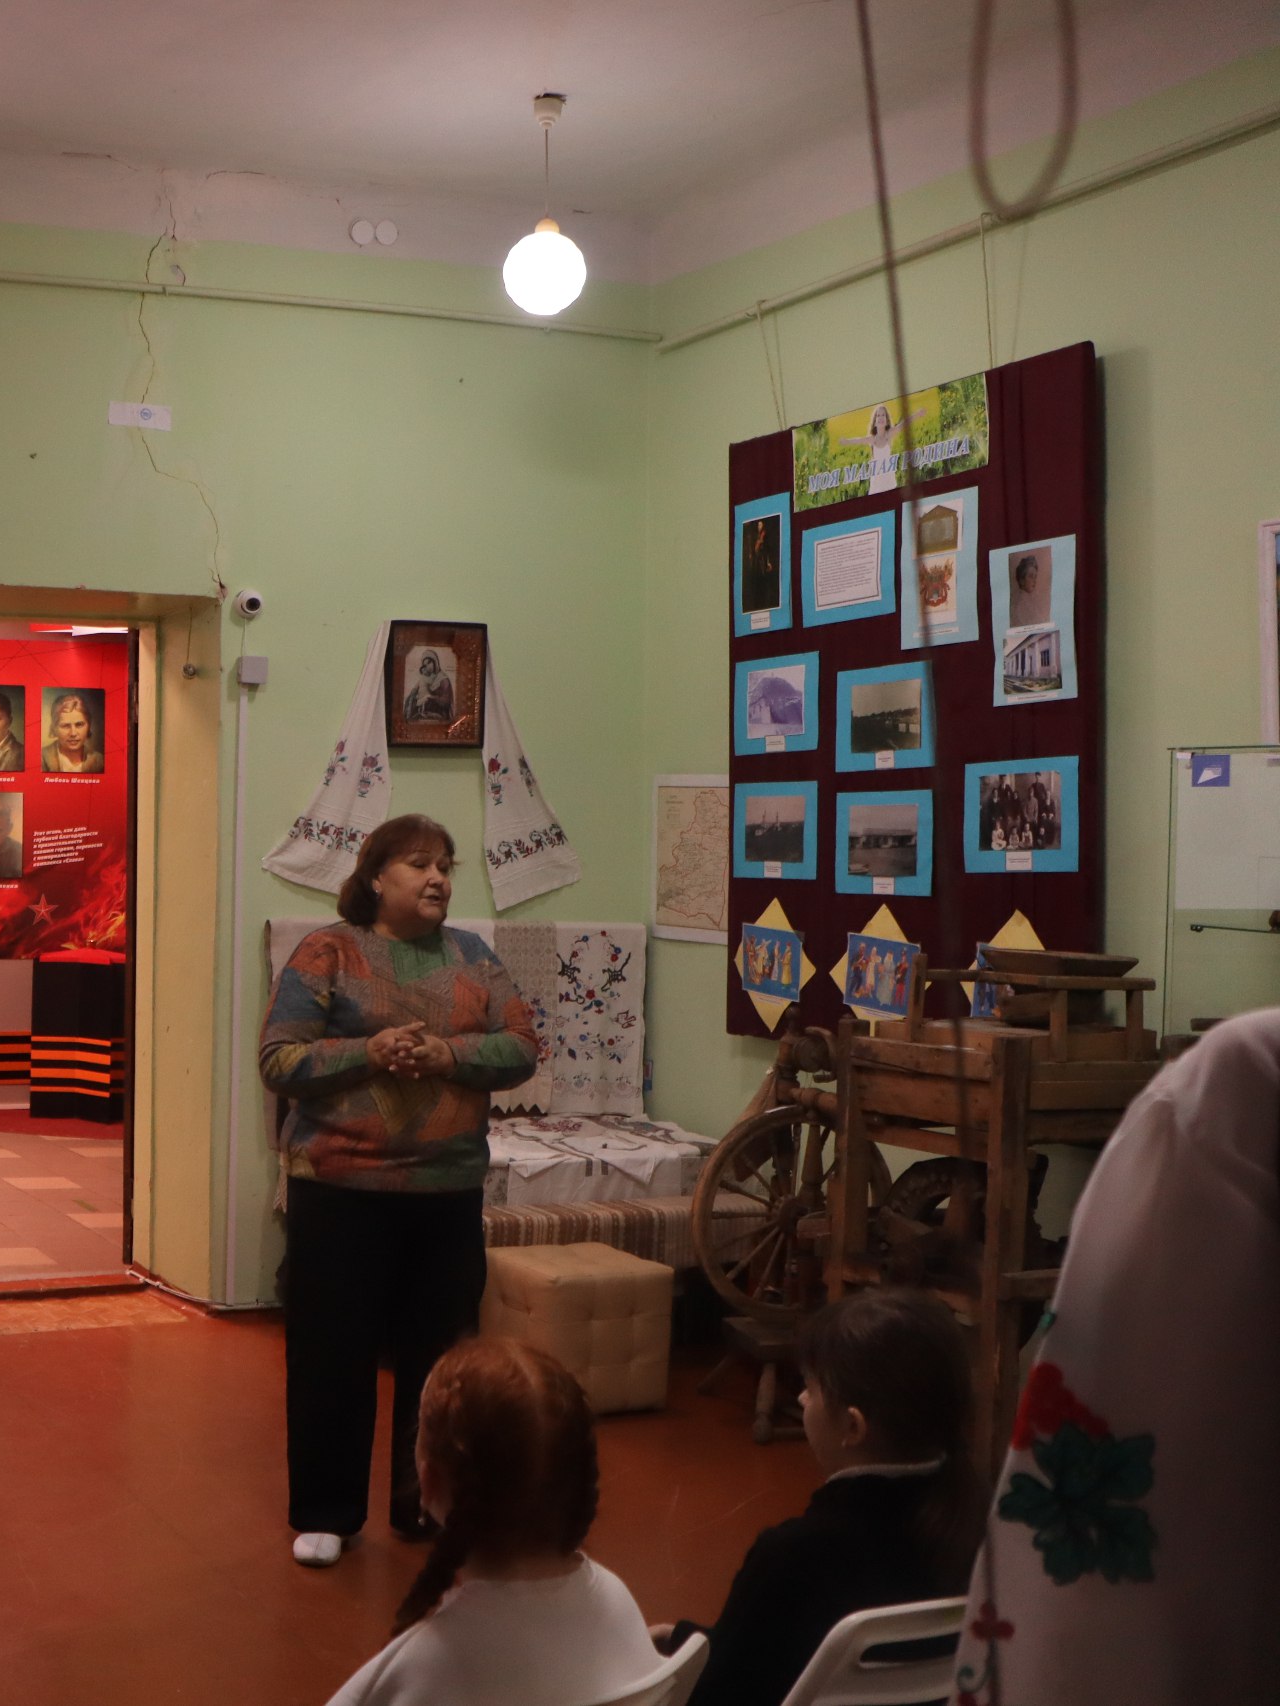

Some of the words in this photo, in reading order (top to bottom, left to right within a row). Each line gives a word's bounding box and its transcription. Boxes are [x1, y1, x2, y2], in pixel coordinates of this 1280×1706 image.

[808, 468, 840, 493] МОЯ
[843, 454, 899, 485] МАЛАЯ
[902, 436, 970, 471] РОДИНА
